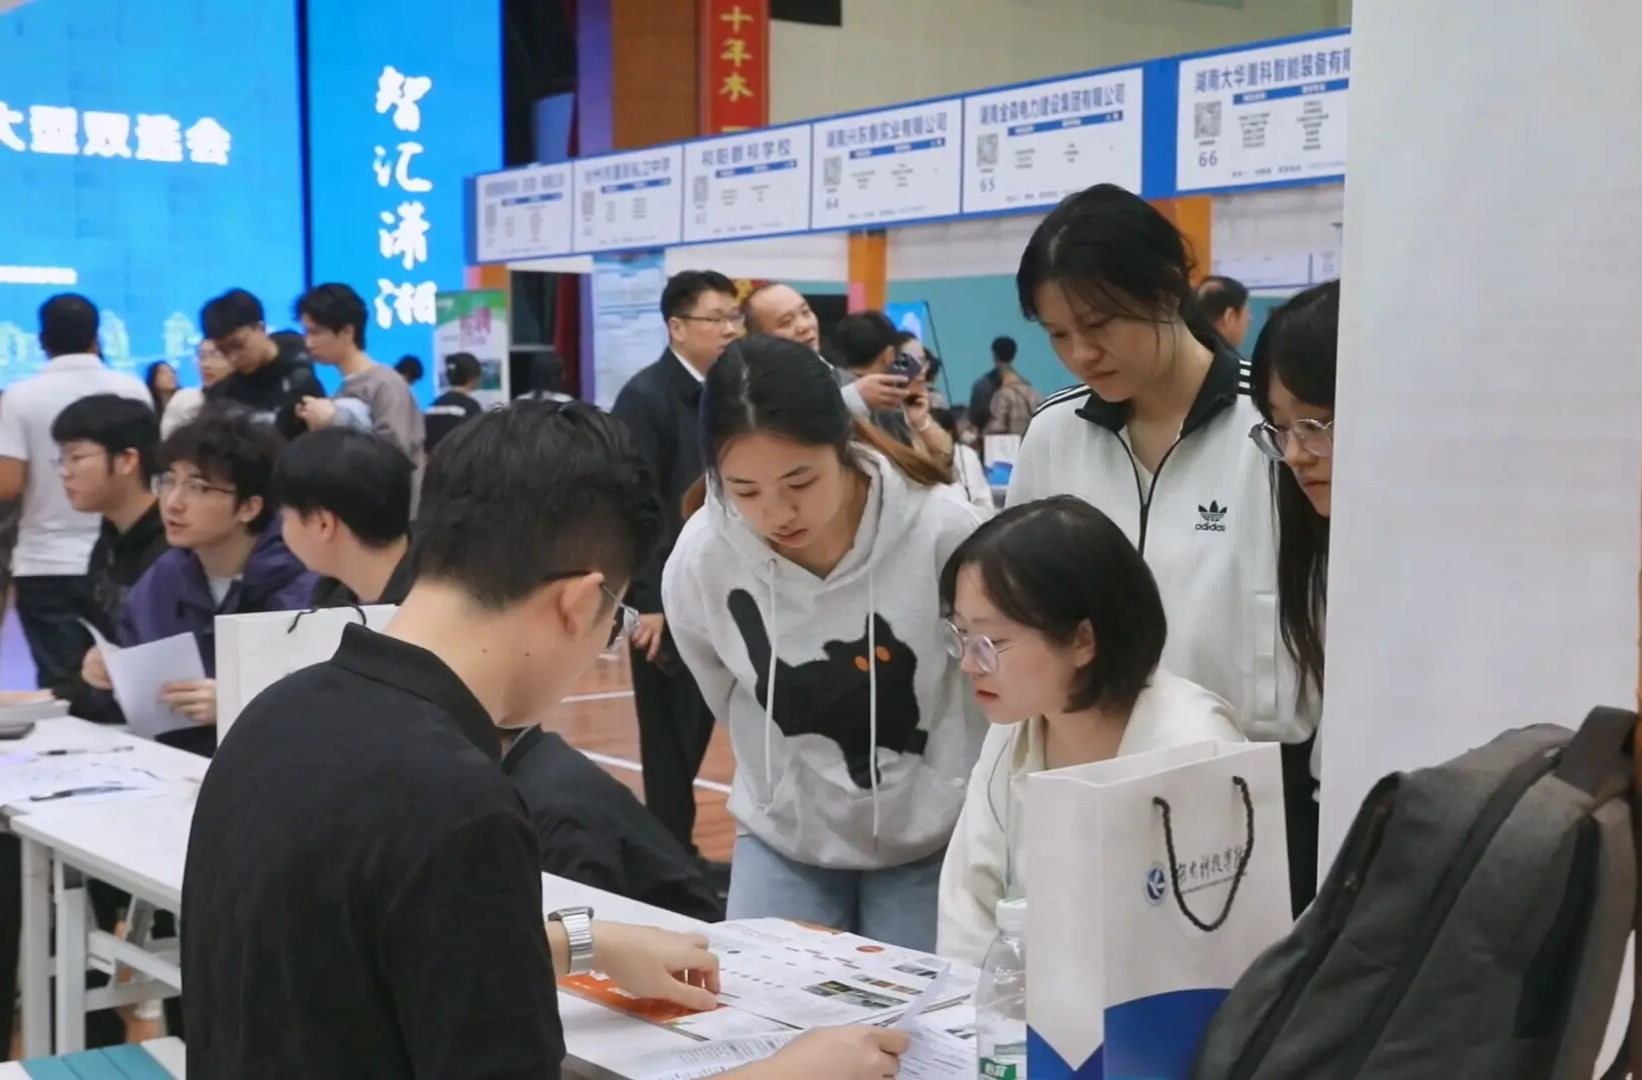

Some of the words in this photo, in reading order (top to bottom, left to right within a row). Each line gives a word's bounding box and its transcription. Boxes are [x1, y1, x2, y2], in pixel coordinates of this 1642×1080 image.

[1198, 150, 1218, 168] 66
[980, 176, 995, 193] 65
[373, 65, 437, 329] 智汇潇湘
[1195, 522, 1225, 532] adidas
